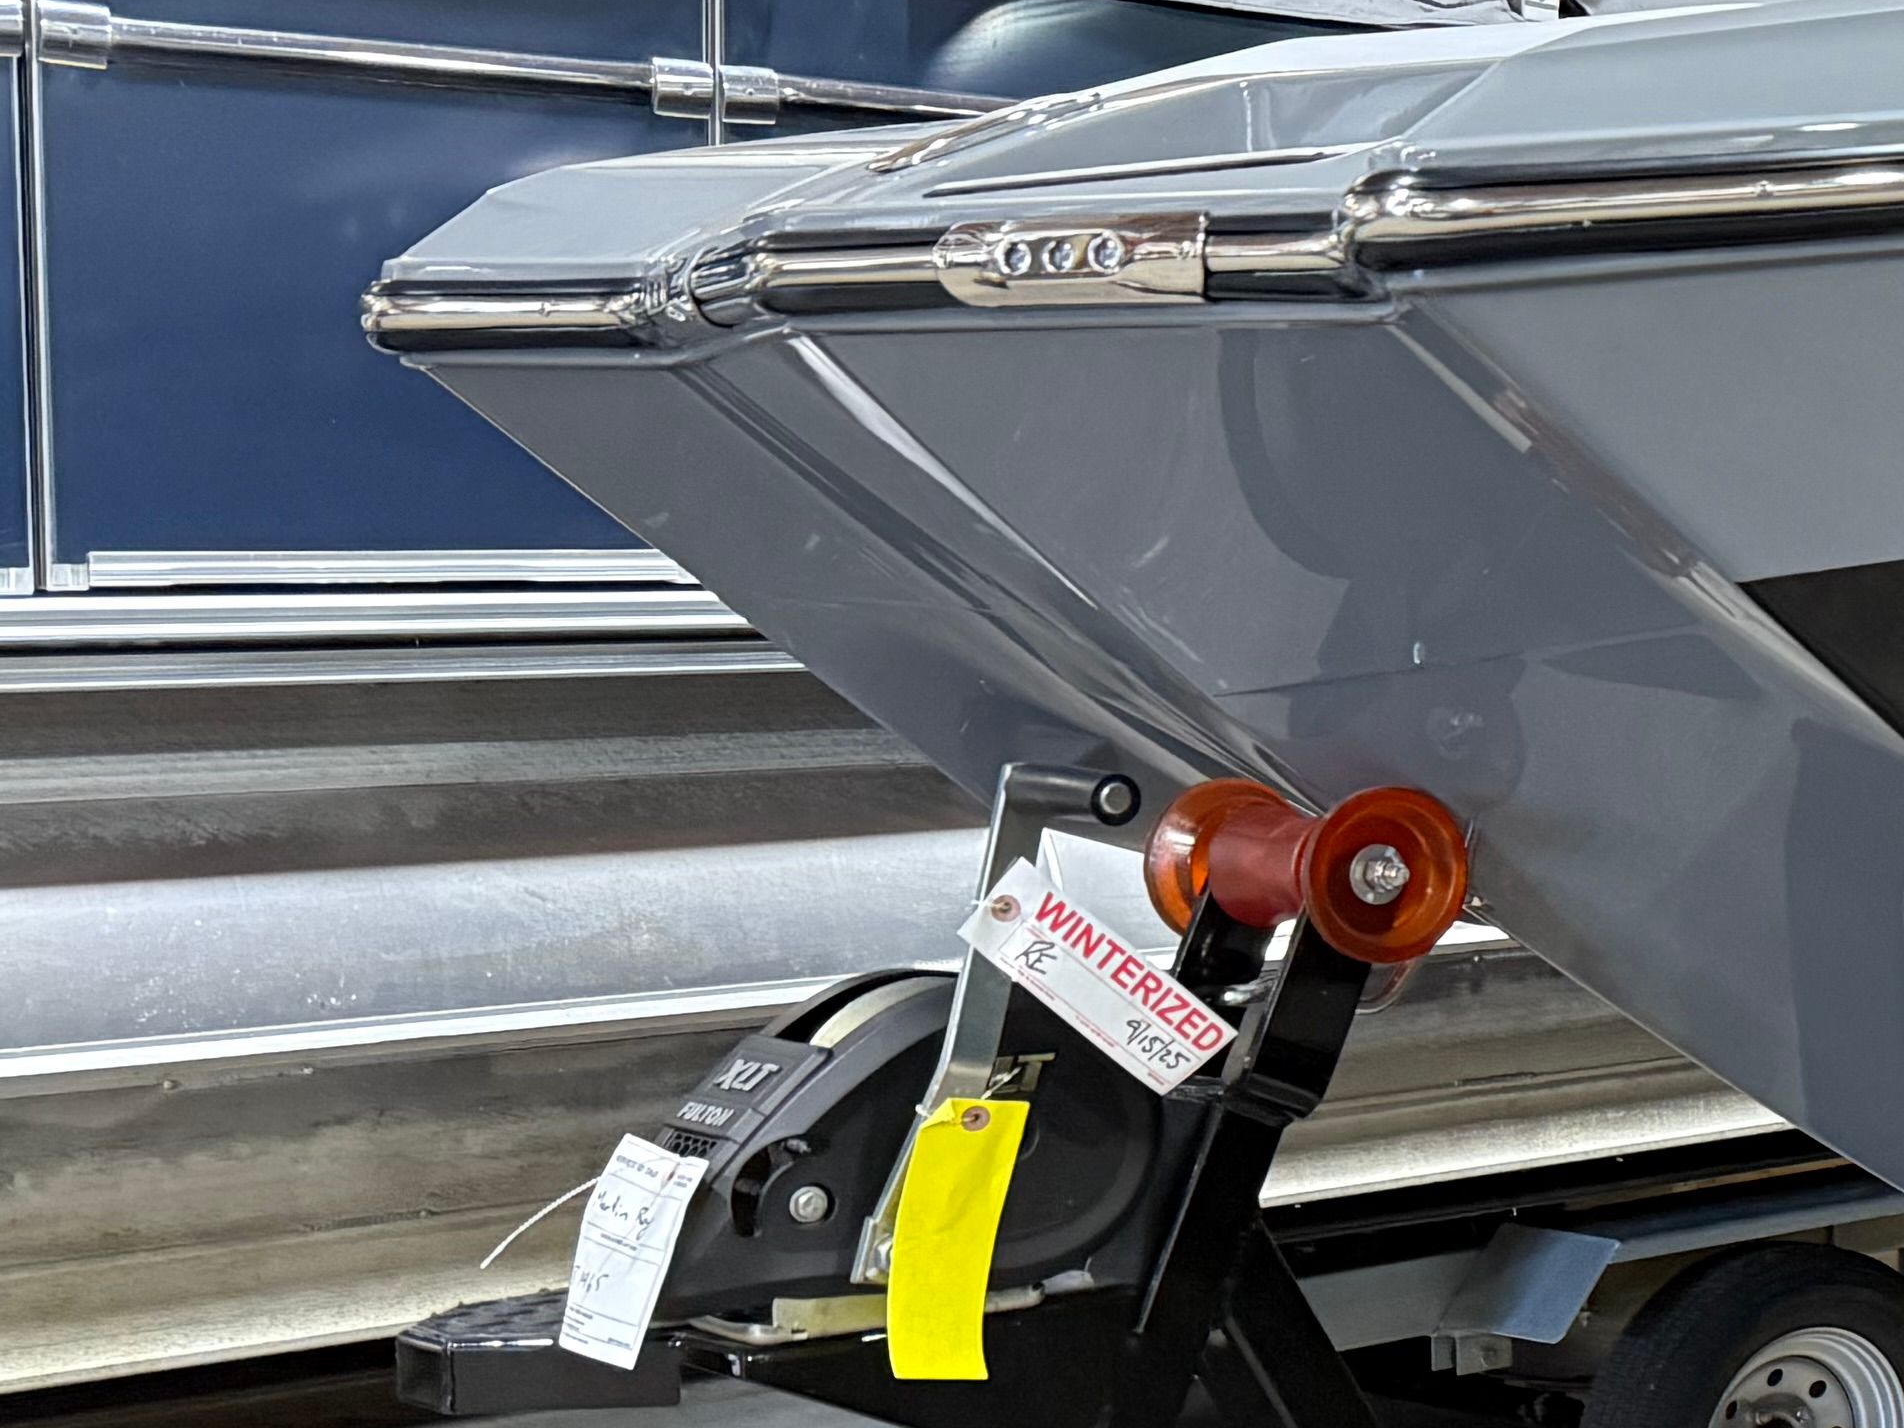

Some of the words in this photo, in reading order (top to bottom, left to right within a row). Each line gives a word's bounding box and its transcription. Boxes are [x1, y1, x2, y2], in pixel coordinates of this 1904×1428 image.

[1034, 890, 1225, 1052] WINTERIZED
[712, 1058, 781, 1092] XLT
[676, 1101, 736, 1128] FULTON
